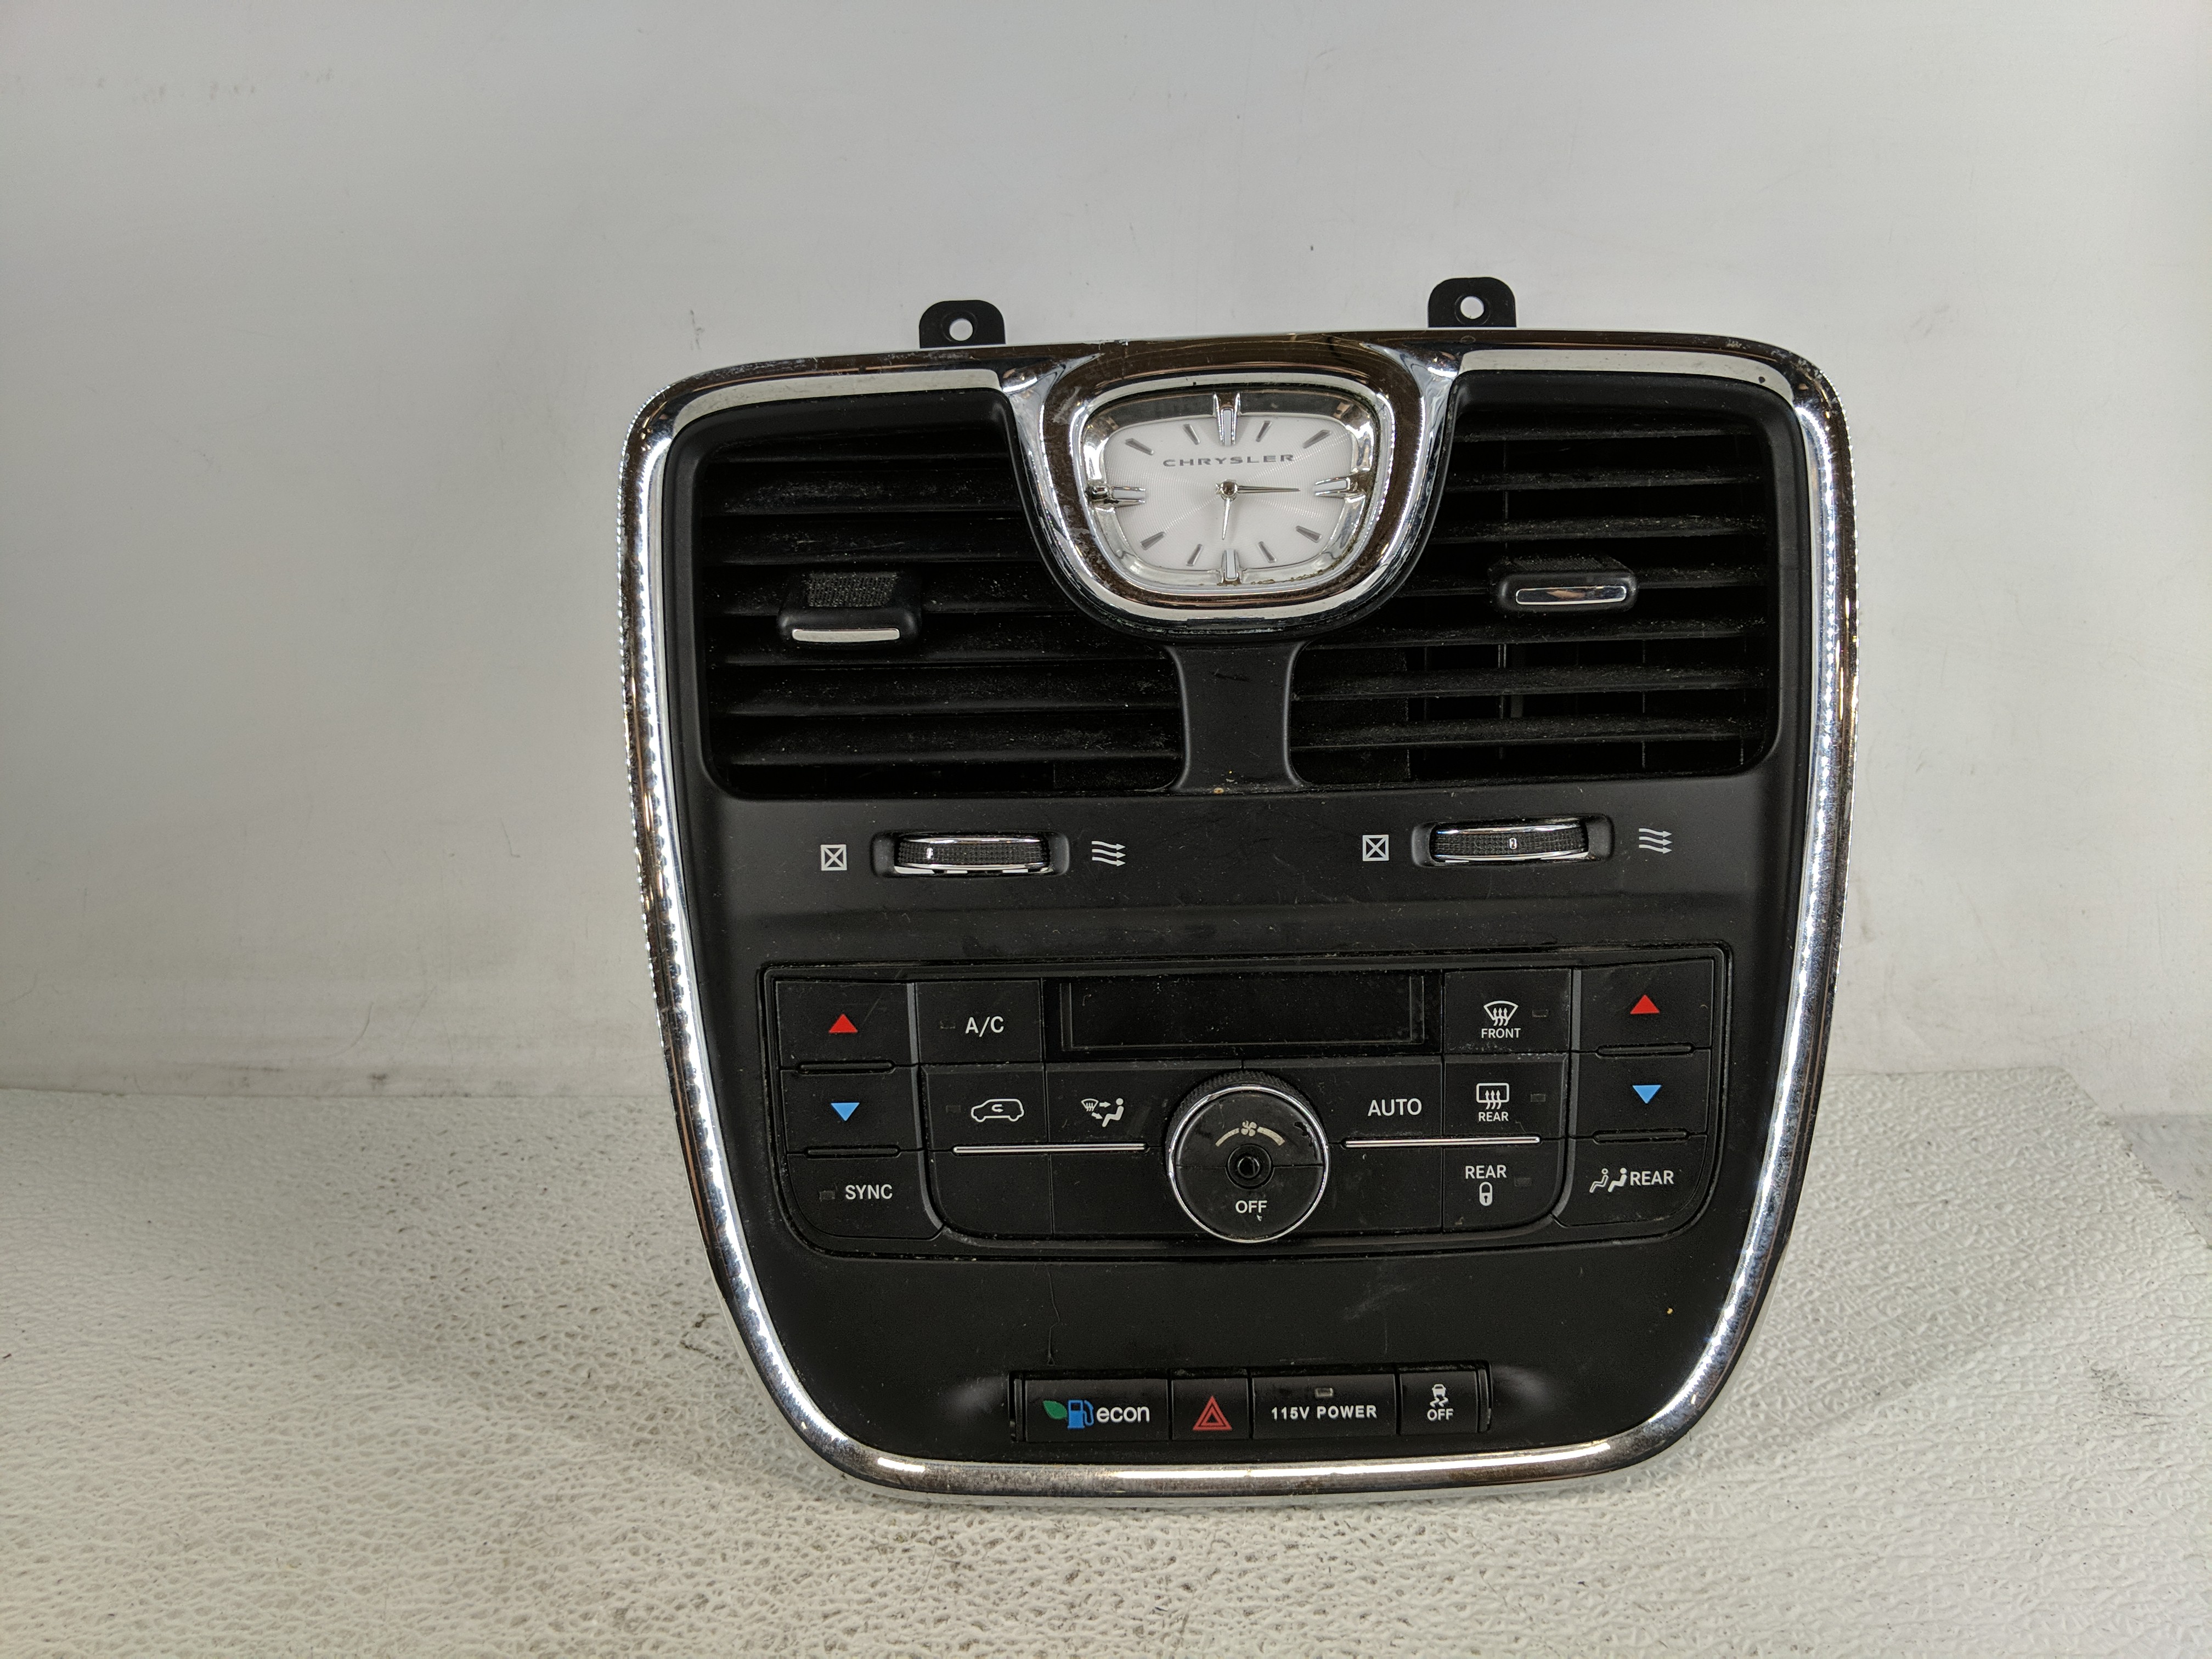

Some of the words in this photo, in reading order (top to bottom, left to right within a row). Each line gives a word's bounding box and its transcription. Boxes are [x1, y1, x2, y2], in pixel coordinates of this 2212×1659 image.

[1163, 454, 1294, 467] CHRYSLER
[965, 1015, 1004, 1037] A/C
[1481, 1028, 1521, 1039] FRONT
[1367, 1098, 1422, 1116] AUTO
[1478, 1111, 1509, 1122] REAR
[1465, 1164, 1507, 1180] REAR
[1630, 1170, 1674, 1186] REAR
[845, 1184, 893, 1200] SYNC
[1235, 1200, 1268, 1214] OFF
[1096, 1406, 1150, 1423] econ
[1271, 1406, 1310, 1420] 115V
[1317, 1404, 1377, 1419] POWER
[1426, 1408, 1454, 1421] OFF
